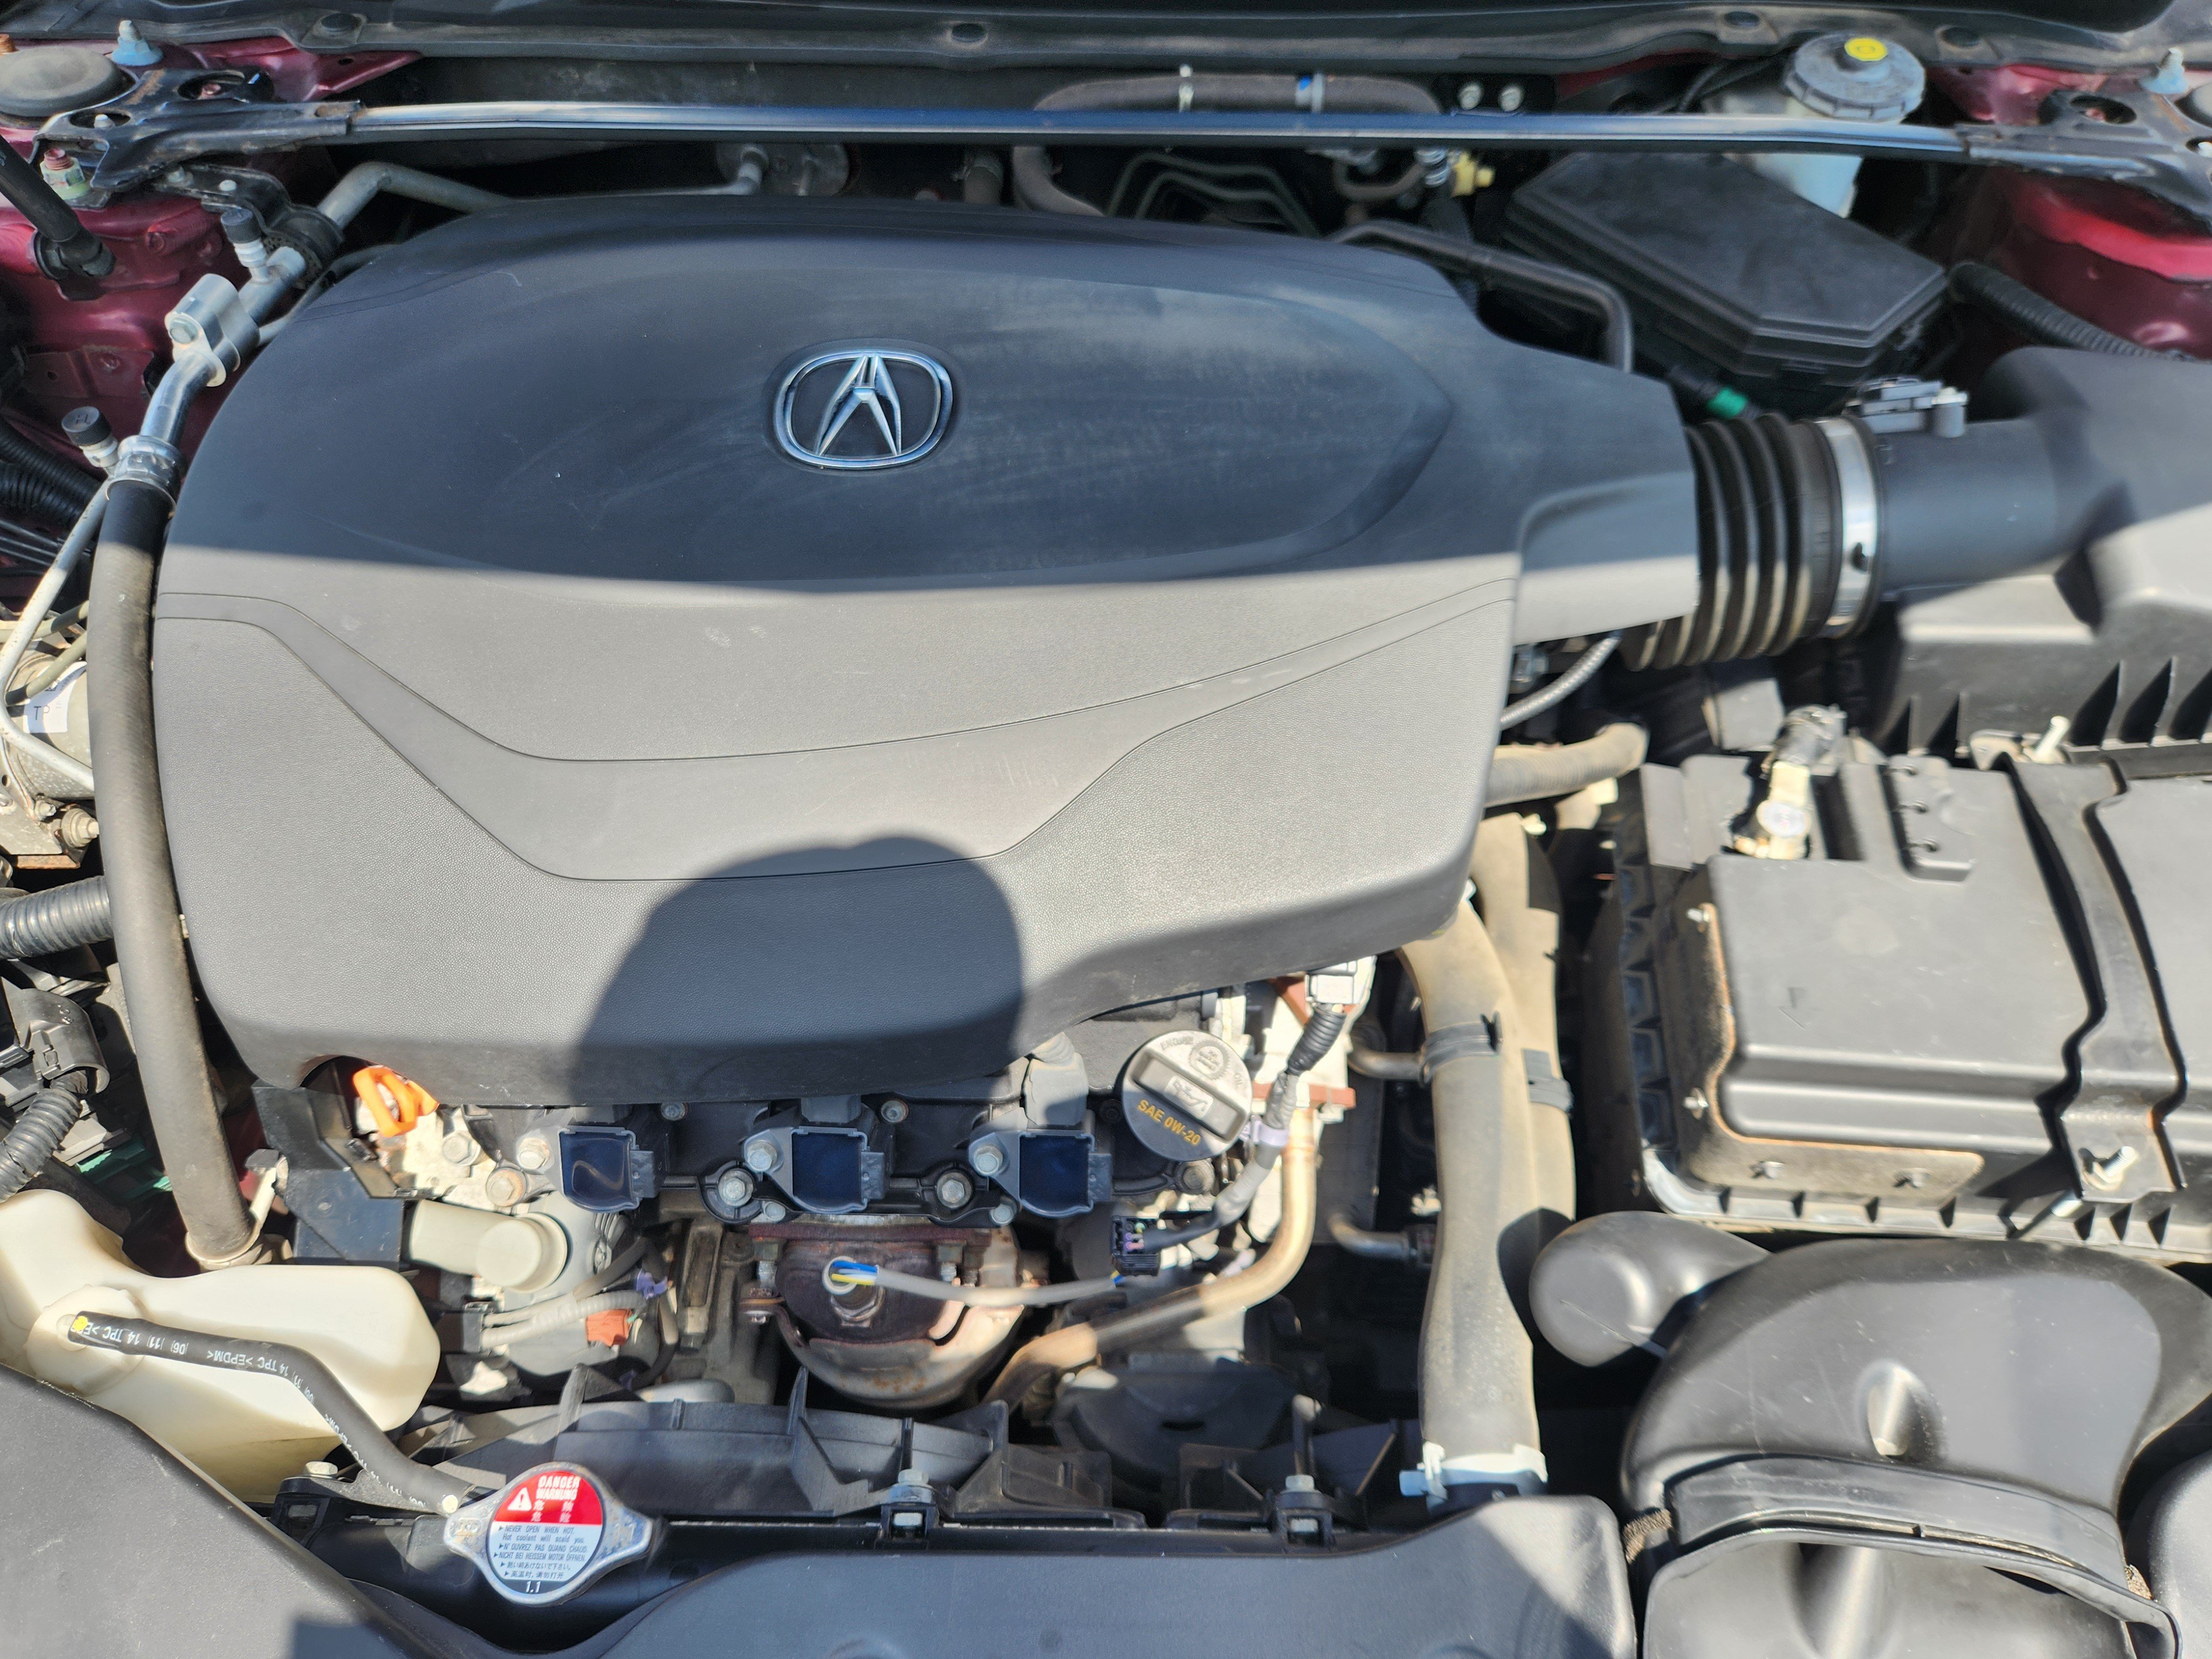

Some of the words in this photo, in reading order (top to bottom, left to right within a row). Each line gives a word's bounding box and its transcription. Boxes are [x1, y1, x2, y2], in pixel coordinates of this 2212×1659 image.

[1137, 1099, 1165, 1123] SAE
[1164, 1116, 1201, 1146] 0W-20
[102, 1326, 124, 1343] TPC
[127, 1331, 141, 1345] 14
[257, 1357, 277, 1372] TPC
[538, 1475, 581, 1489] DANGER
[525, 1580, 542, 1594] 1.1
